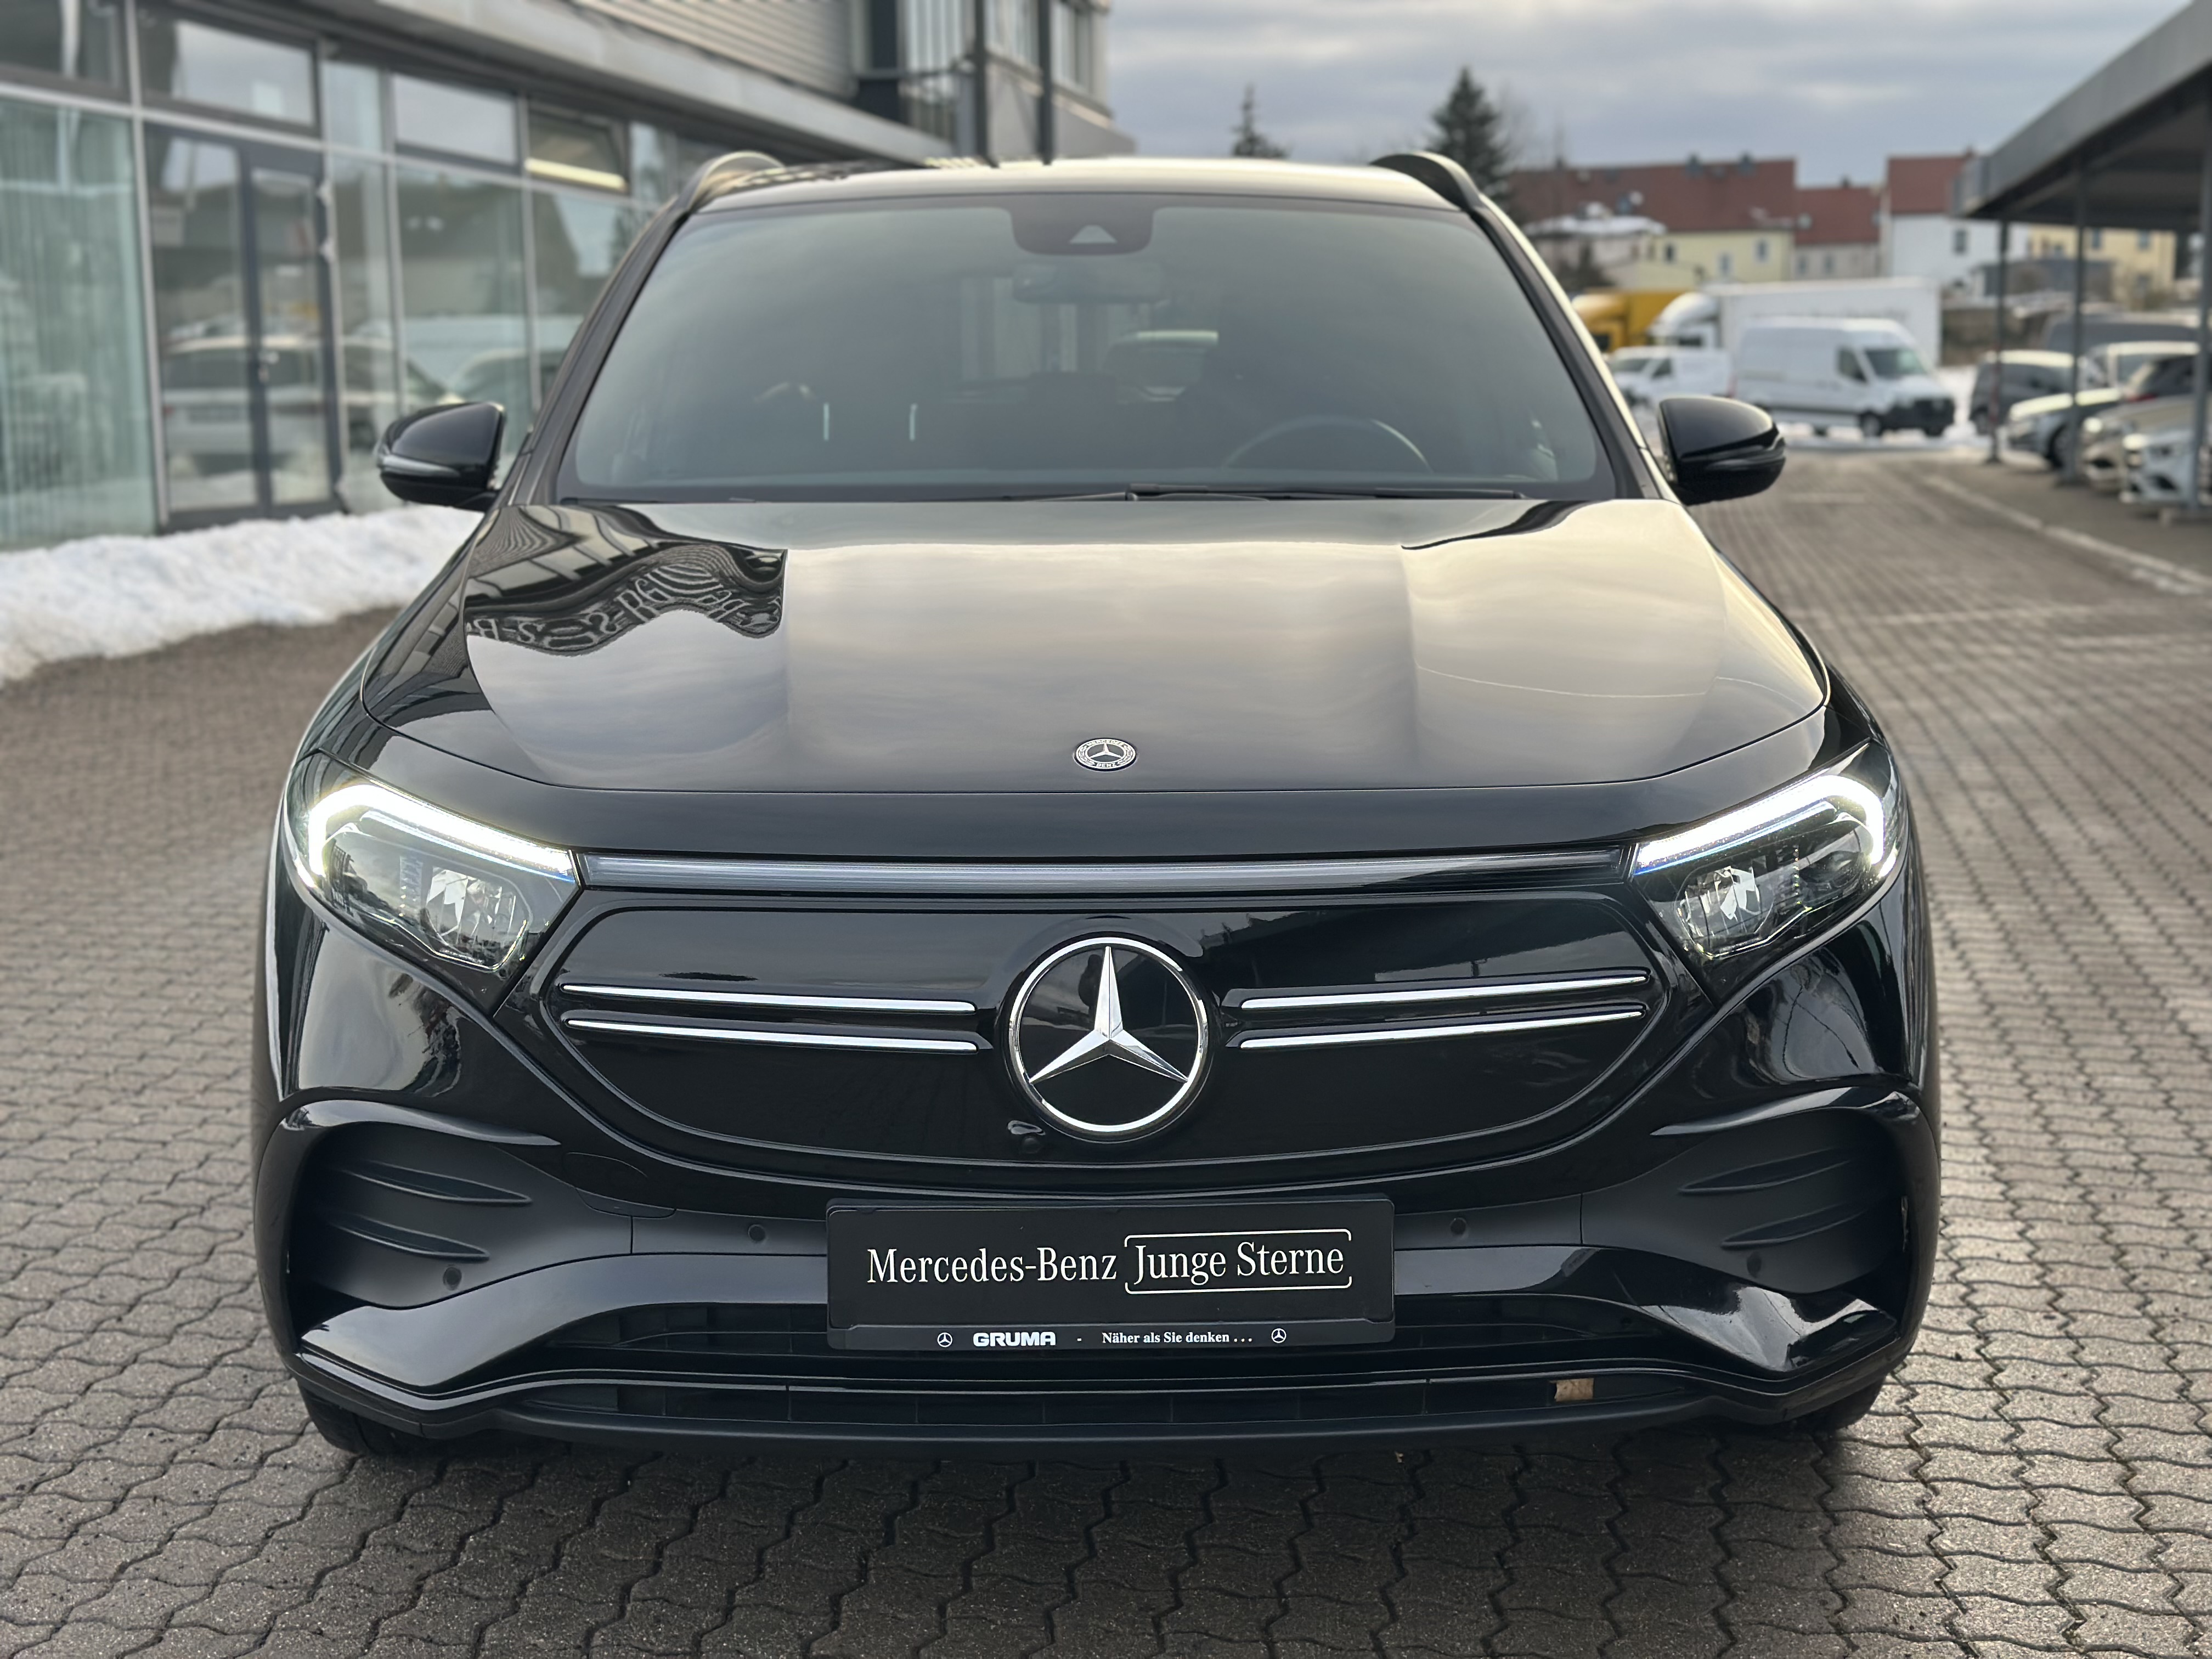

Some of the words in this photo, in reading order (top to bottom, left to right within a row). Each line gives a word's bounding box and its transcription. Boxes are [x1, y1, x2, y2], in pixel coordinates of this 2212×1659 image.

[867, 1247, 1117, 1283] Mercedes-Benz
[1133, 1245, 1226, 1285] Junge
[1237, 1242, 1344, 1276] Sterne
[973, 1331, 1056, 1347] GRUMA
[1102, 1331, 1141, 1344] Näher
[1143, 1331, 1161, 1343] als
[1163, 1331, 1182, 1343] Sie
[1185, 1331, 1230, 1343] denken
